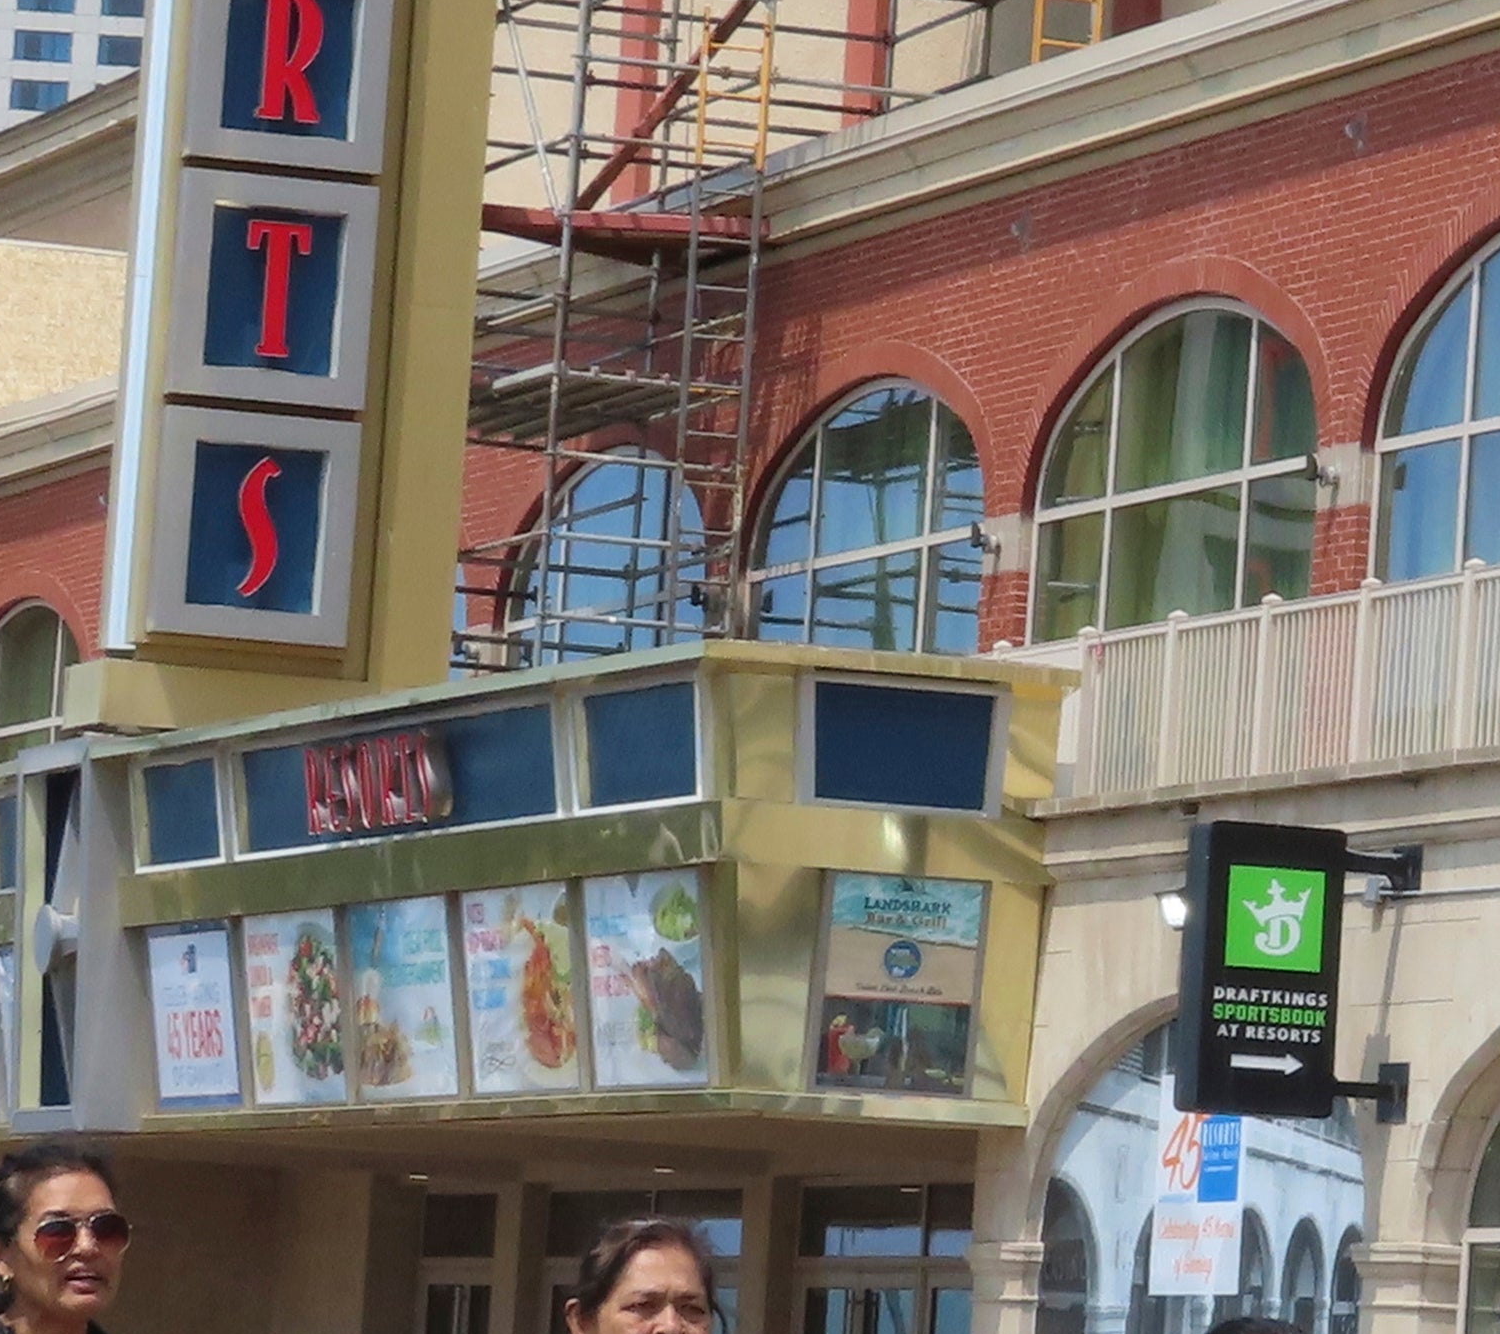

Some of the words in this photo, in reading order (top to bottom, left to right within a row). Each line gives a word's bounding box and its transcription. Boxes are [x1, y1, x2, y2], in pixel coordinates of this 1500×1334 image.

[304, 729, 438, 835] RESORTS
[864, 897, 951, 915] LANDSHARK
[864, 911, 892, 925] Bar
[911, 915, 948, 929] Grill
[1213, 986, 1328, 1007] DRAFTKINGS
[1213, 1003, 1326, 1027] SPORTSBOOK
[1216, 1024, 1239, 1037] AT
[1245, 1025, 1321, 1043] RESORTS
